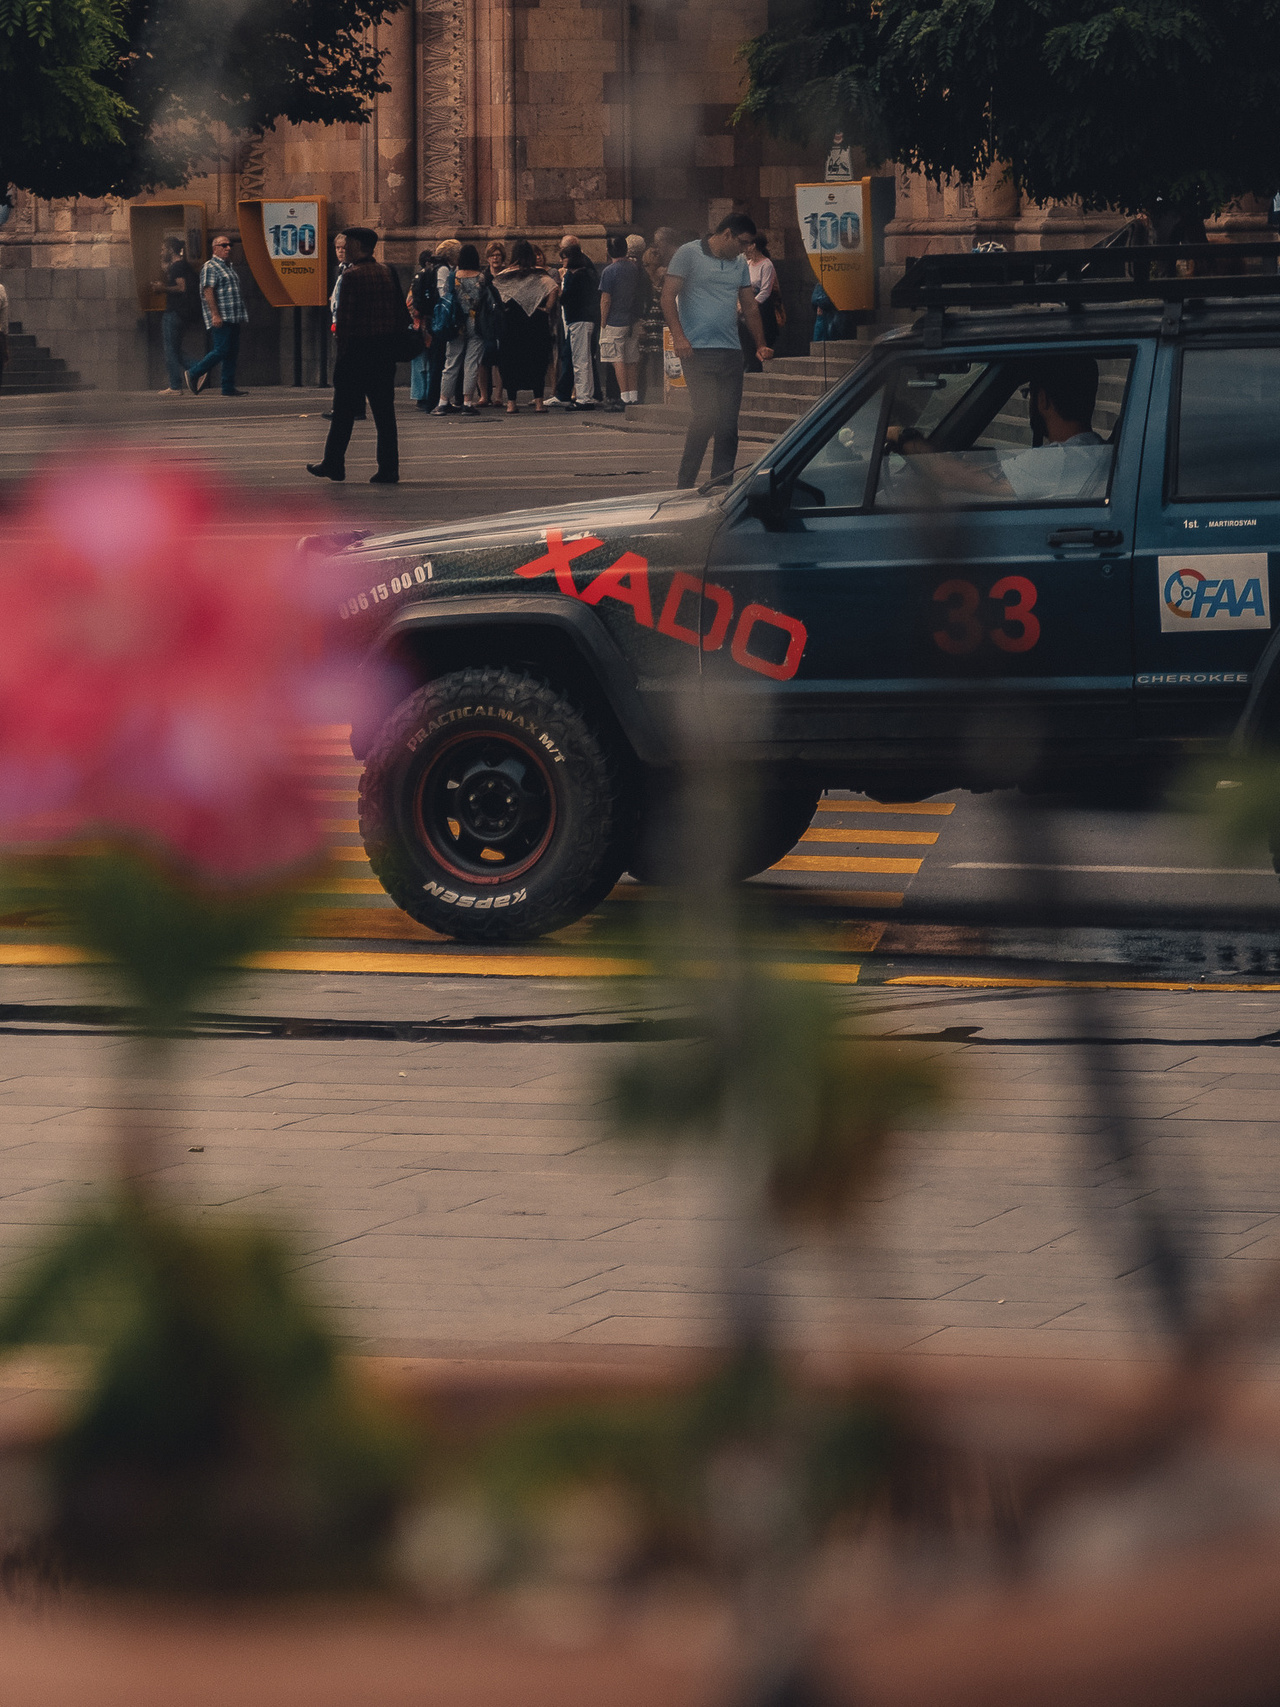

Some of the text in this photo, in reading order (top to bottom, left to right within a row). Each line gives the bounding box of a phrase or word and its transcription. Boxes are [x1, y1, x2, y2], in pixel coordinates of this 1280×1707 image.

[268, 223, 316, 256] 100
[804, 211, 861, 250] 100
[370, 583, 389, 604] 15
[391, 572, 413, 594] 00
[414, 561, 433, 584] 07
[513, 527, 808, 682] XADO
[933, 575, 1041, 654] 33
[1137, 673, 1248, 684] CHEROKEE
[406, 704, 566, 764] PRACTICALMAX M/T
